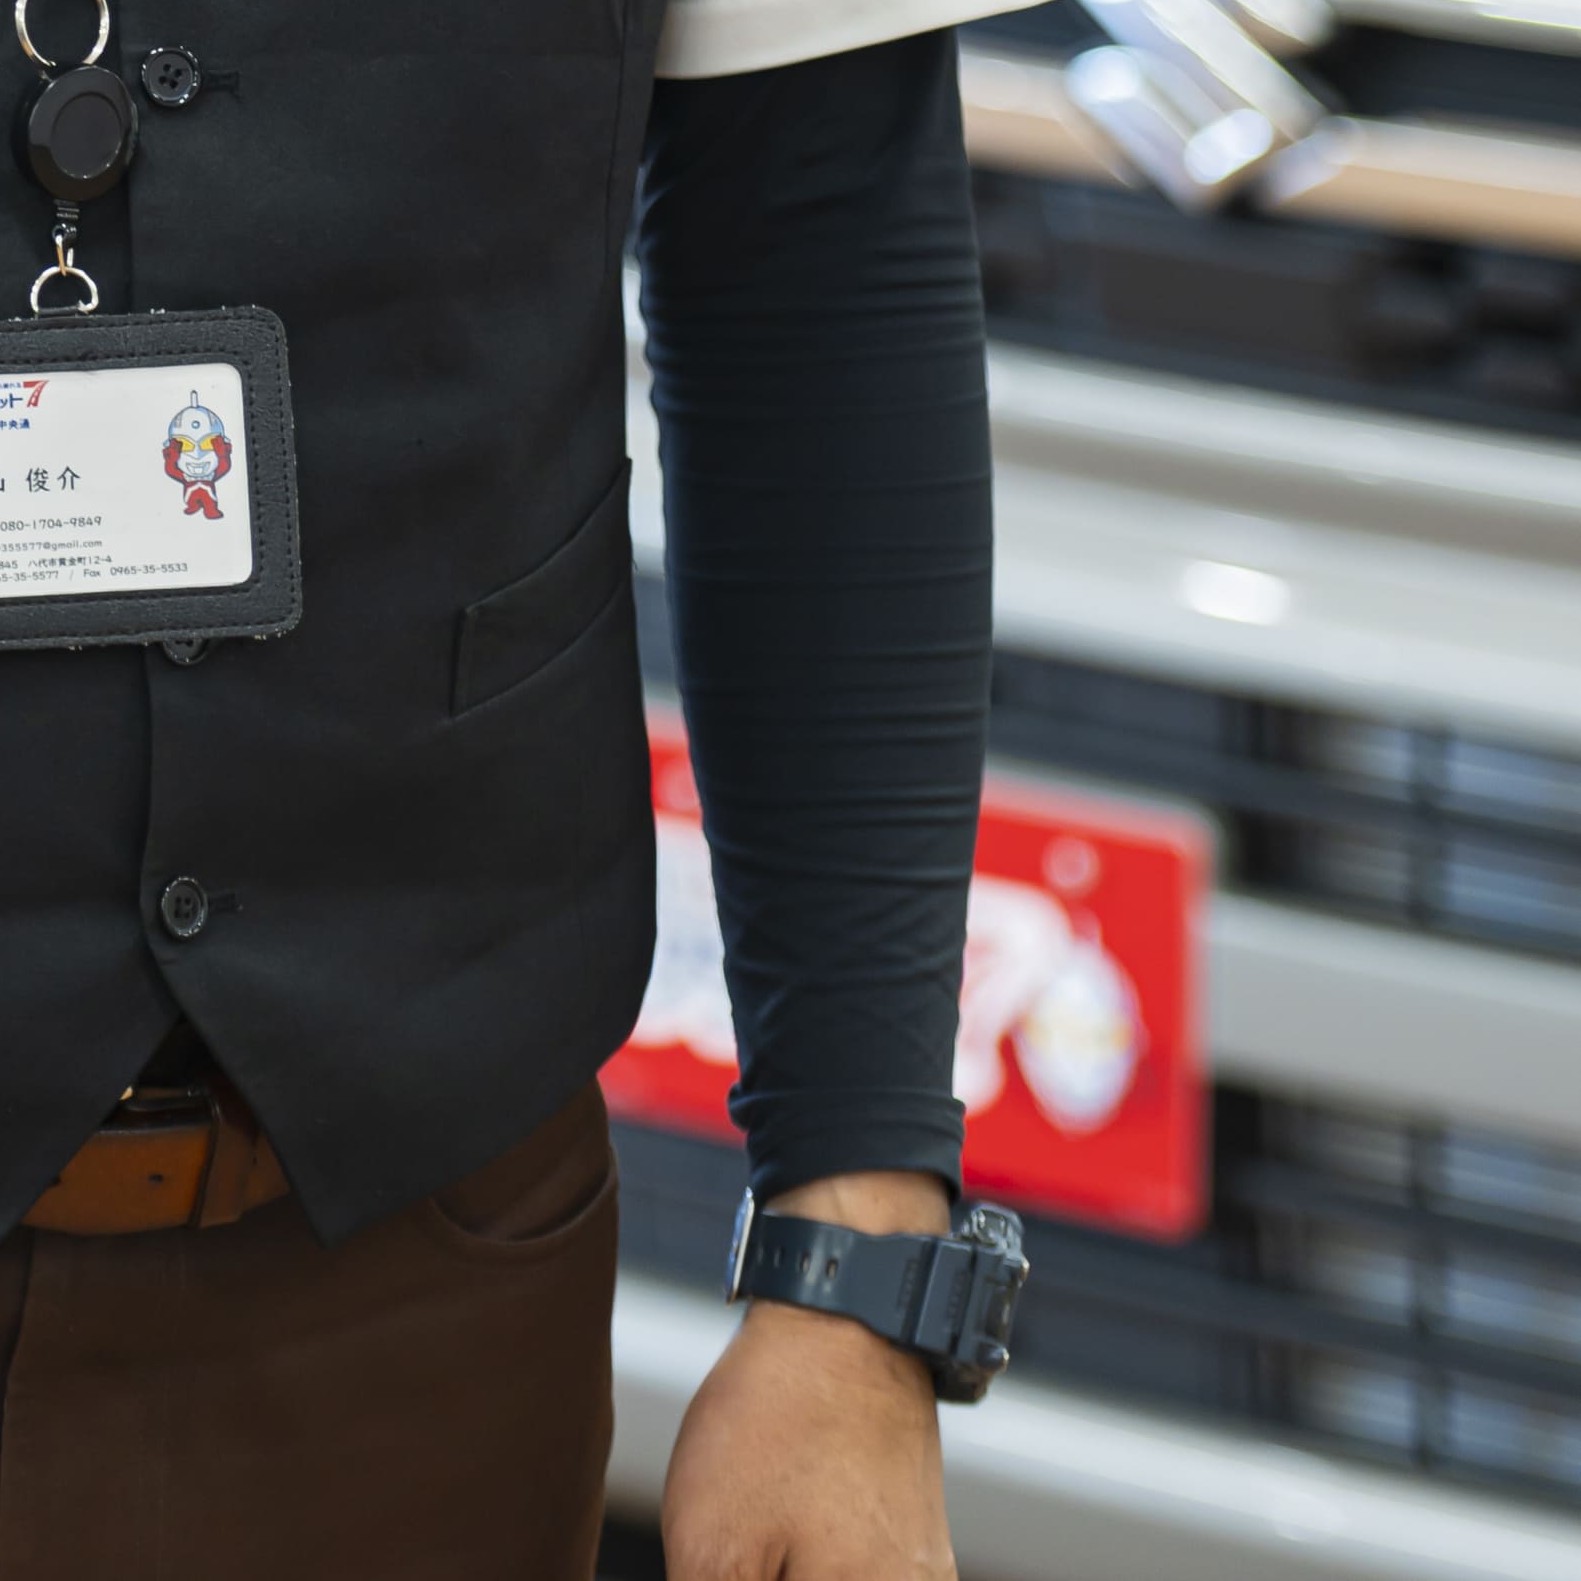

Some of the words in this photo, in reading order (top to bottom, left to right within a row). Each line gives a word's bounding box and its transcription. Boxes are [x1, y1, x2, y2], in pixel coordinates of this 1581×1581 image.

[25, 466, 81, 493] 俊介
[0, 516, 102, 532] 080-1704-9849
[83, 568, 101, 578] Fax
[109, 563, 188, 576] 0965-35-5533
